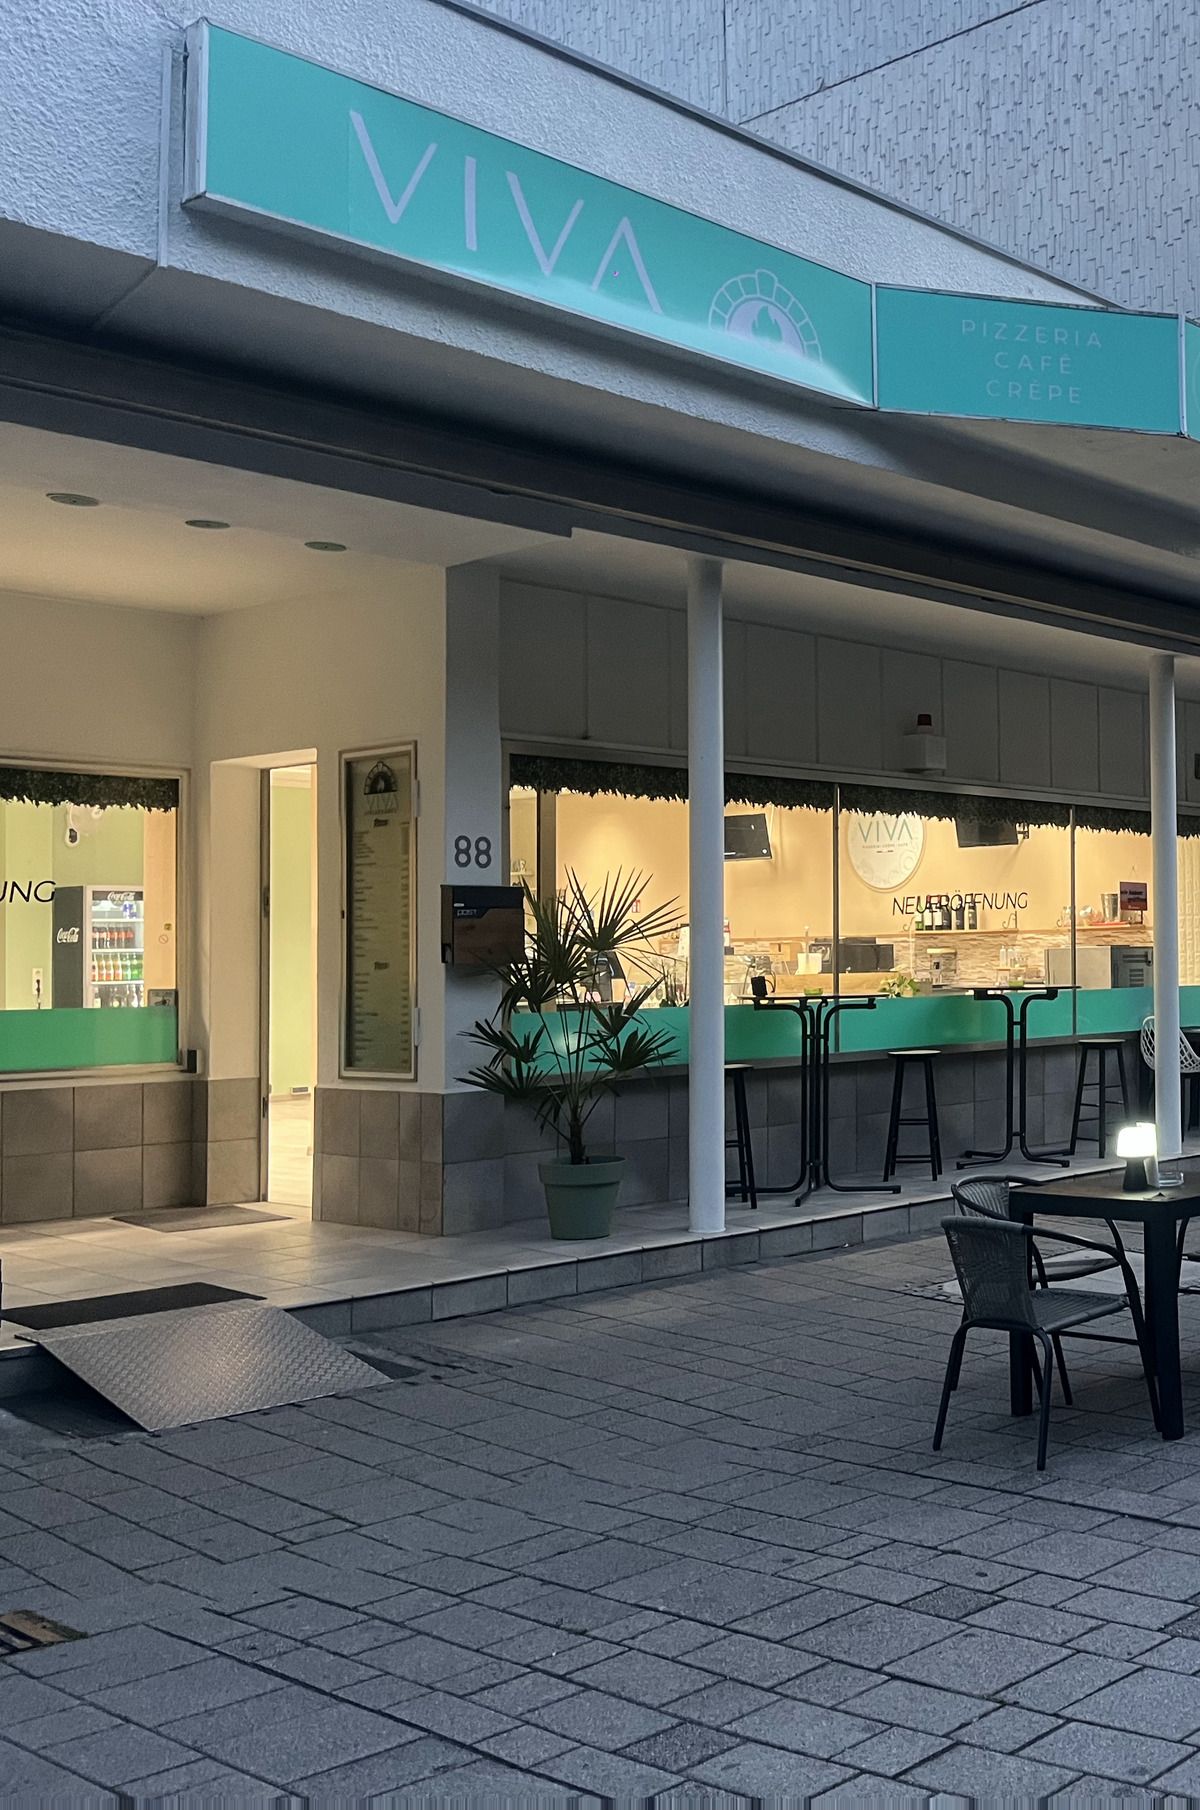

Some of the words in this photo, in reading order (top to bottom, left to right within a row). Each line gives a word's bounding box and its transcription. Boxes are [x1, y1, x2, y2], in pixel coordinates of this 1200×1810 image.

[349, 108, 664, 315] VIVA
[961, 319, 1102, 349] PIZZERIA
[857, 818, 914, 843] VIVA
[454, 835, 492, 869] 88
[892, 889, 1029, 916] NEUERÖFFNUNG
